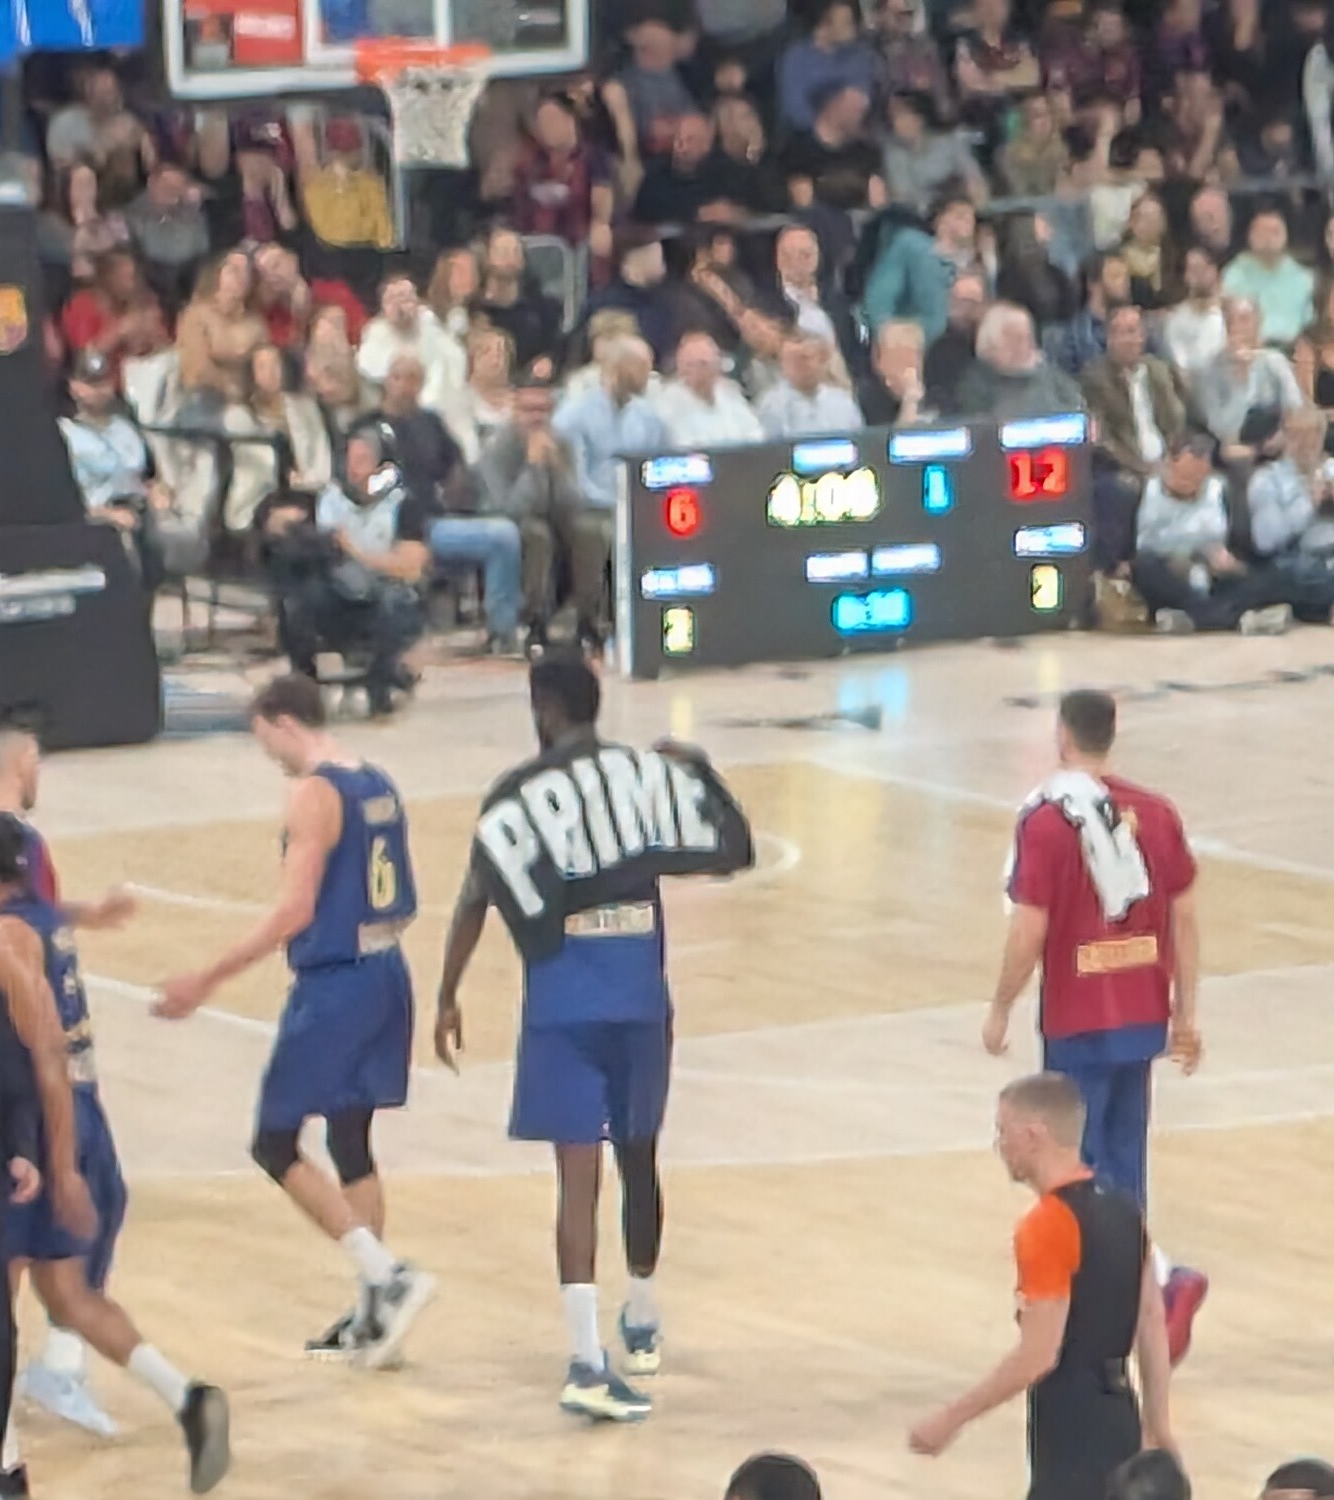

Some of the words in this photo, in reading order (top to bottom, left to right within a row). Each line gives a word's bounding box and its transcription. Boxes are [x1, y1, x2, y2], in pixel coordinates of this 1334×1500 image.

[666, 487, 701, 539] 6
[478, 748, 716, 919] PRIME
[370, 836, 397, 910] 6
